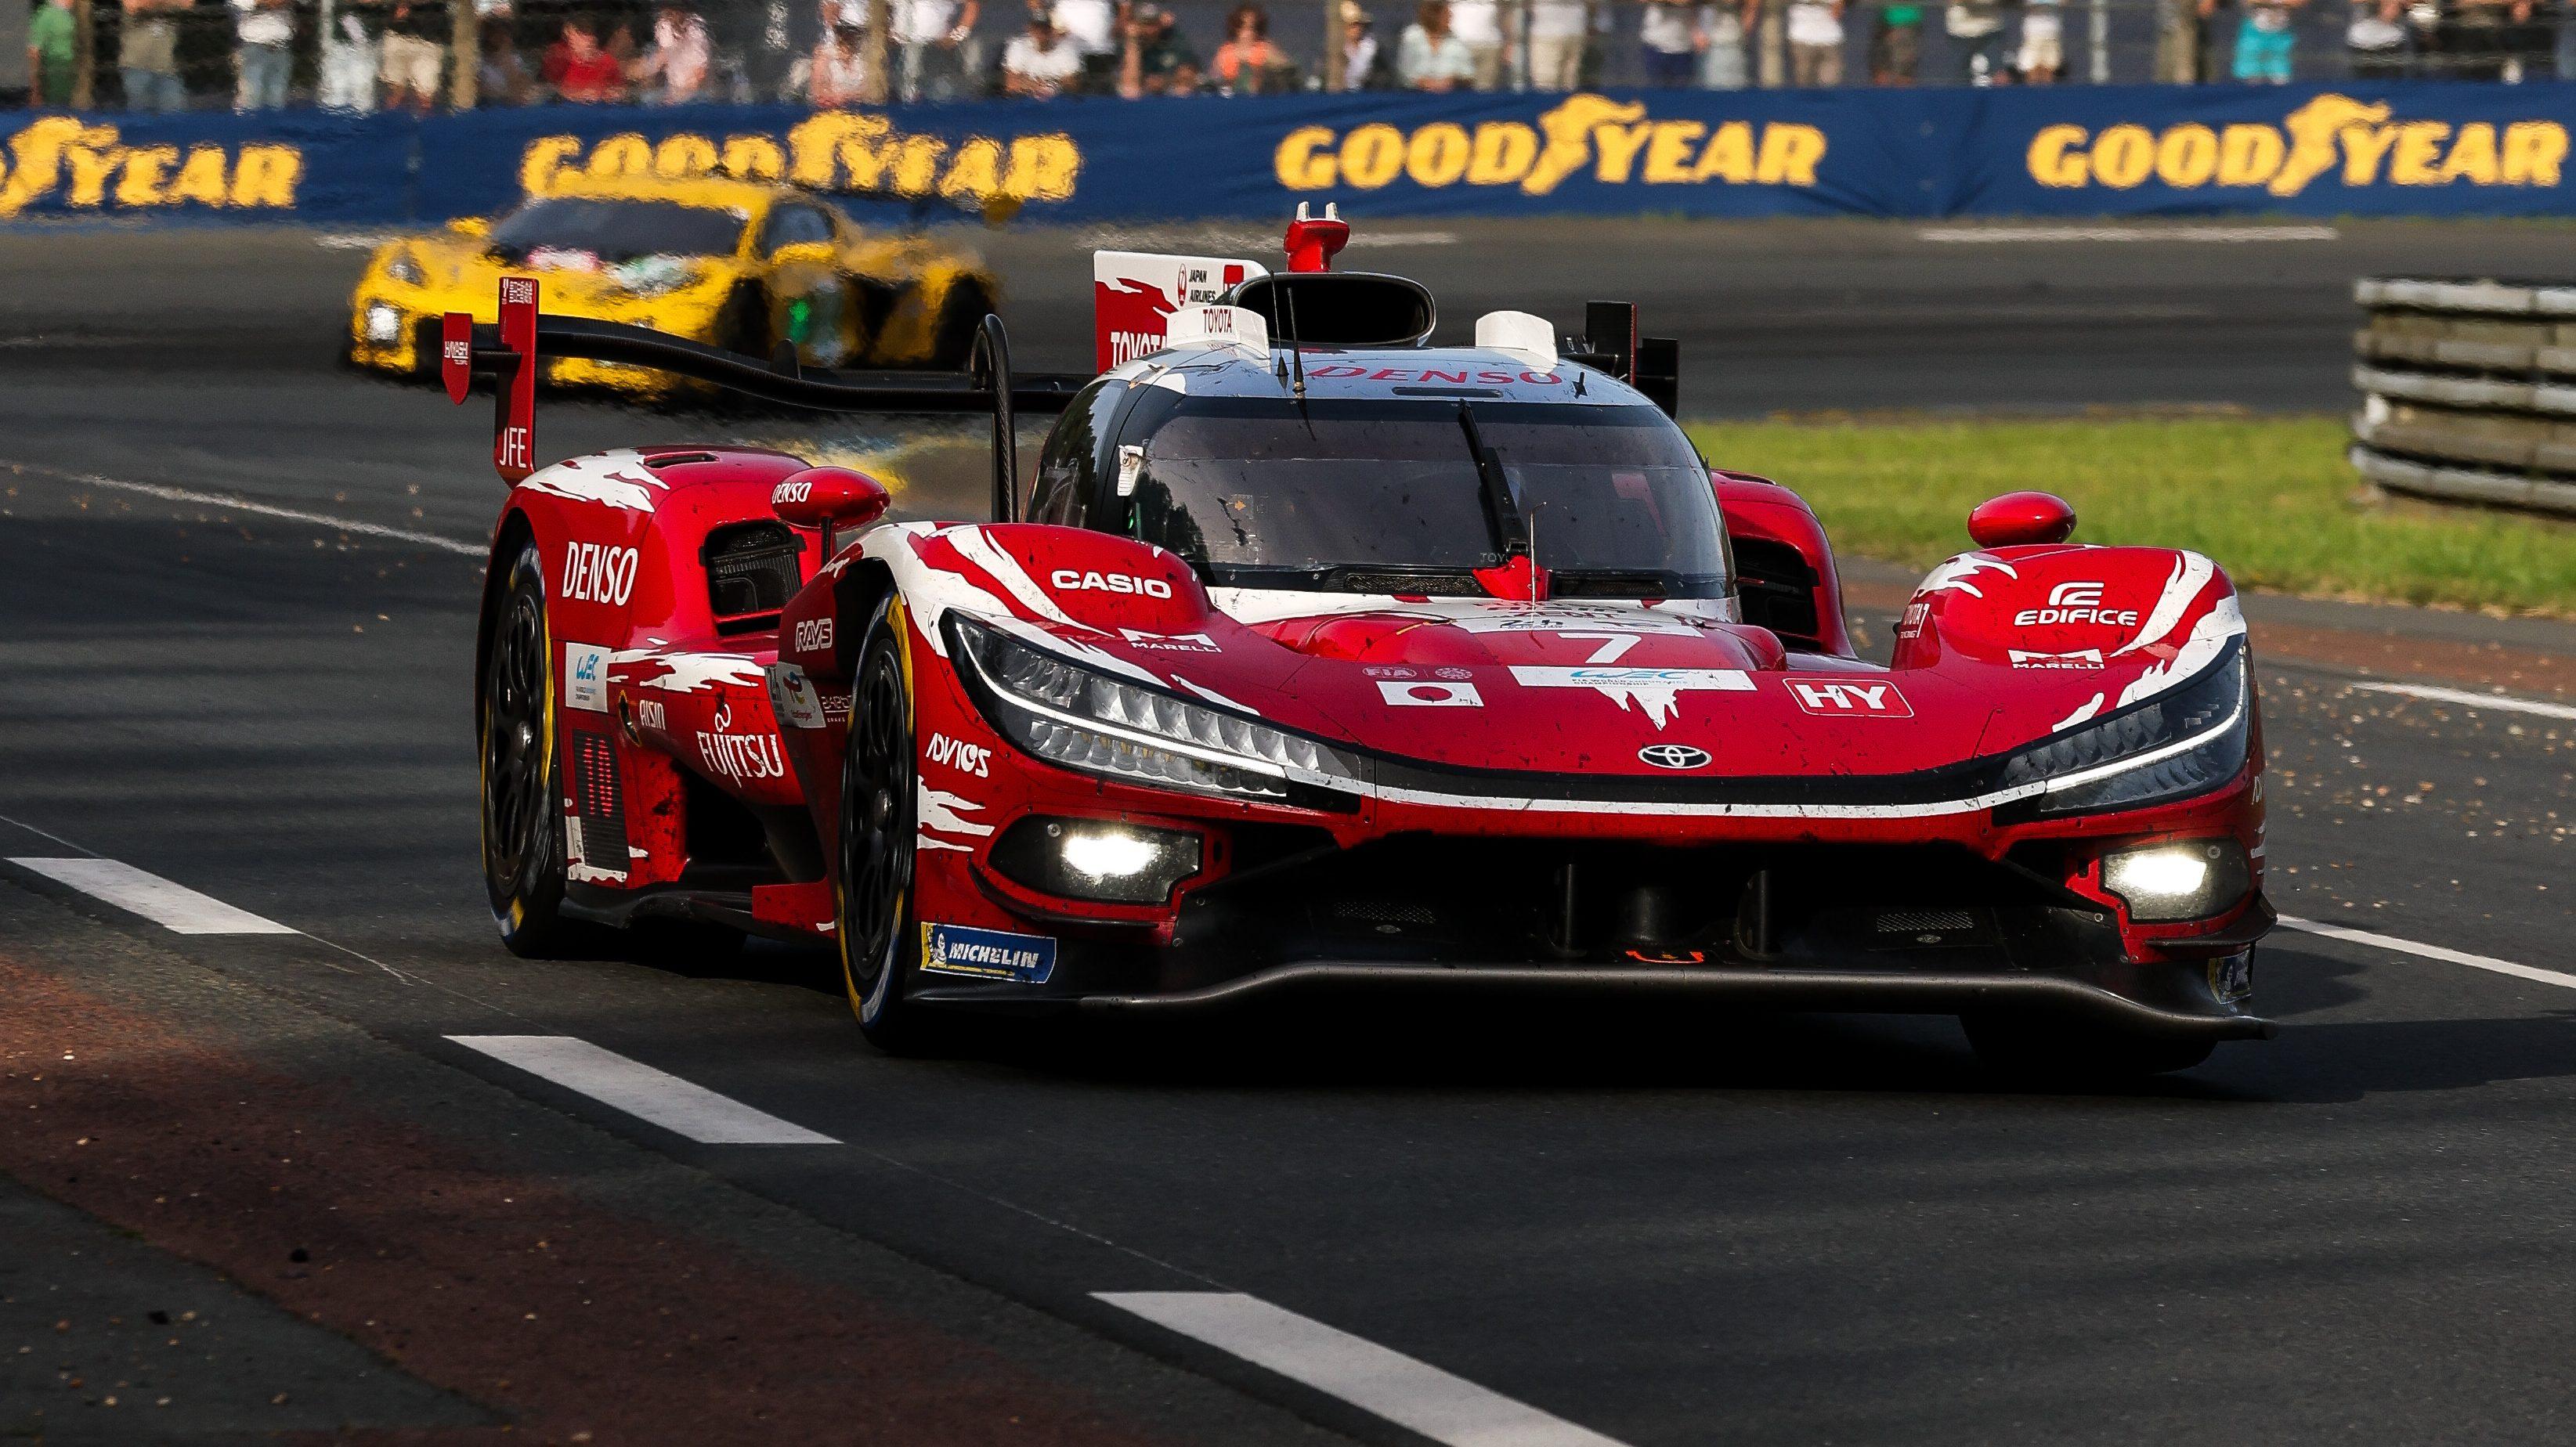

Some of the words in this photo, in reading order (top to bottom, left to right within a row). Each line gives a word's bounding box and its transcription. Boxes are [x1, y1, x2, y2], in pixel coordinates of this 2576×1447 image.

[1274, 119, 1826, 191] GOODYEAR
[2027, 120, 2571, 189] GOODYEAR
[1189, 269, 1207, 283] JAPAN
[1189, 290, 1216, 304] AIRLINES
[1202, 309, 1232, 333] TOYOTA
[1110, 330, 1166, 368] TOYOT
[1305, 365, 1563, 384] DENSO
[499, 427, 527, 468] JFE
[771, 482, 812, 503] DENSO
[562, 540, 638, 606] DENSO
[1051, 569, 1172, 599] CASIO
[2014, 608, 2138, 626] EDIFICE
[795, 618, 833, 652] RAYS
[1130, 642, 1223, 653] MARELLI
[1557, 632, 1642, 663] 7
[1364, 668, 1413, 677] FIA
[1570, 669, 1689, 680] WEC
[1798, 684, 1888, 709] HY
[695, 730, 784, 788] FUJITSU
[948, 942, 1039, 969] MICHELIN
